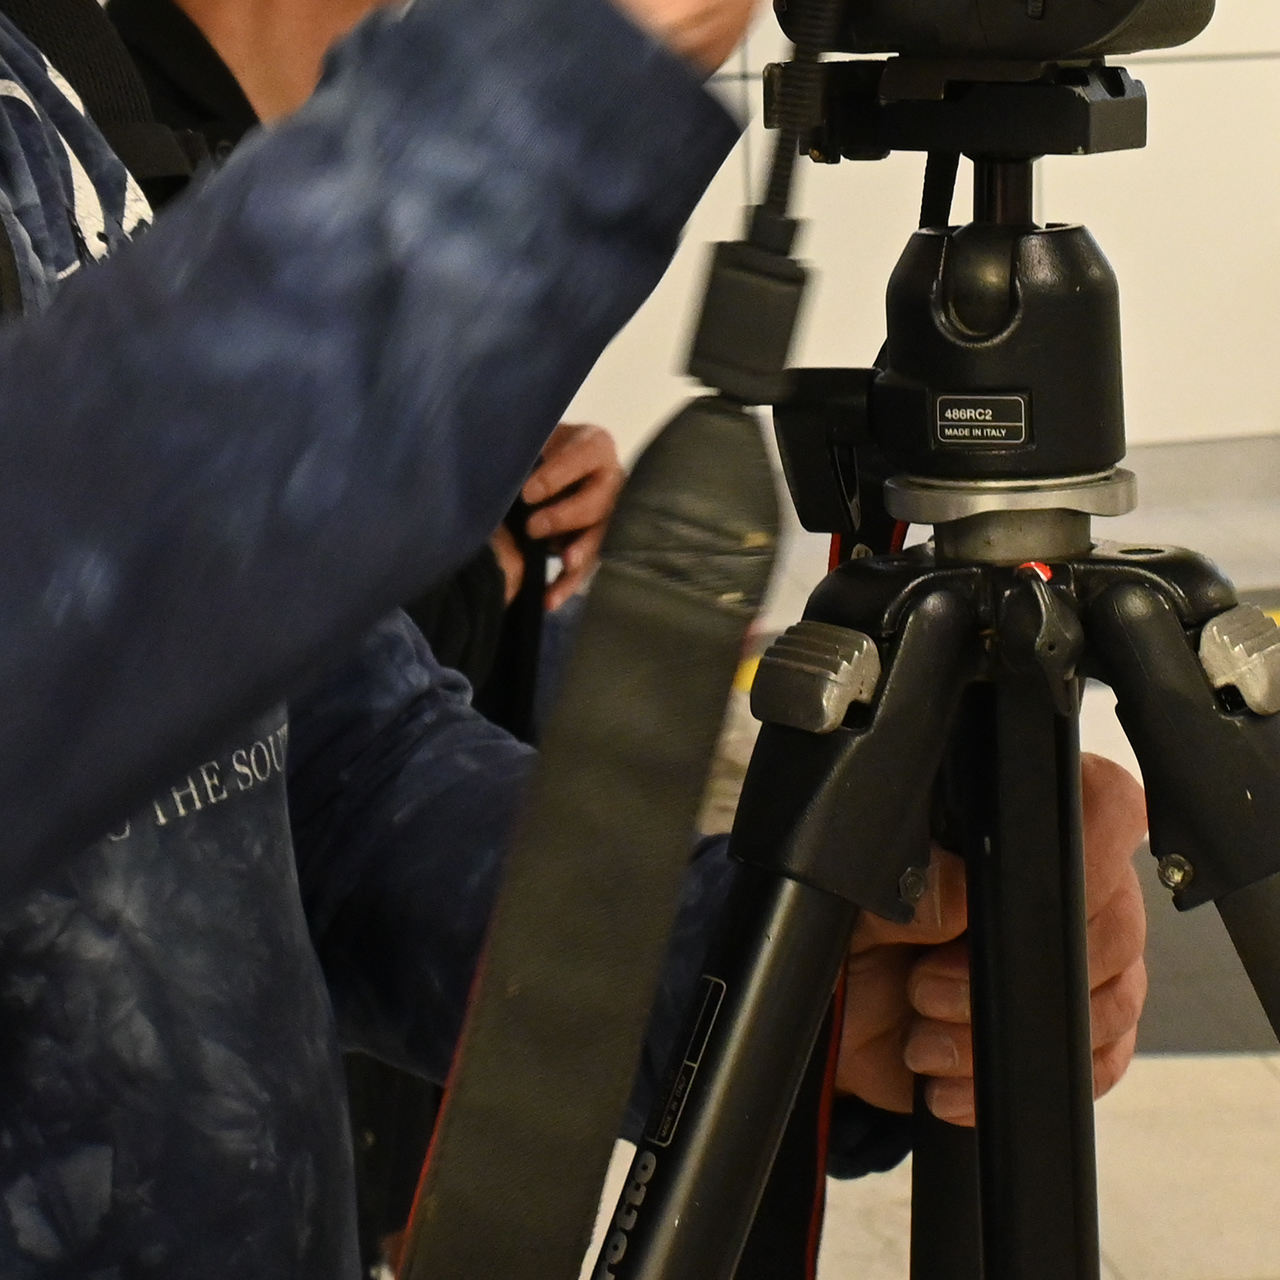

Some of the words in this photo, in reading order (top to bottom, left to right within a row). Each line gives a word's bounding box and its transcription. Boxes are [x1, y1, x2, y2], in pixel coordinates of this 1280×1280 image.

[944, 408, 993, 420] 486RC2
[944, 428, 970, 436] MADE
[972, 428, 982, 436] IN
[983, 428, 1007, 437] ITALY
